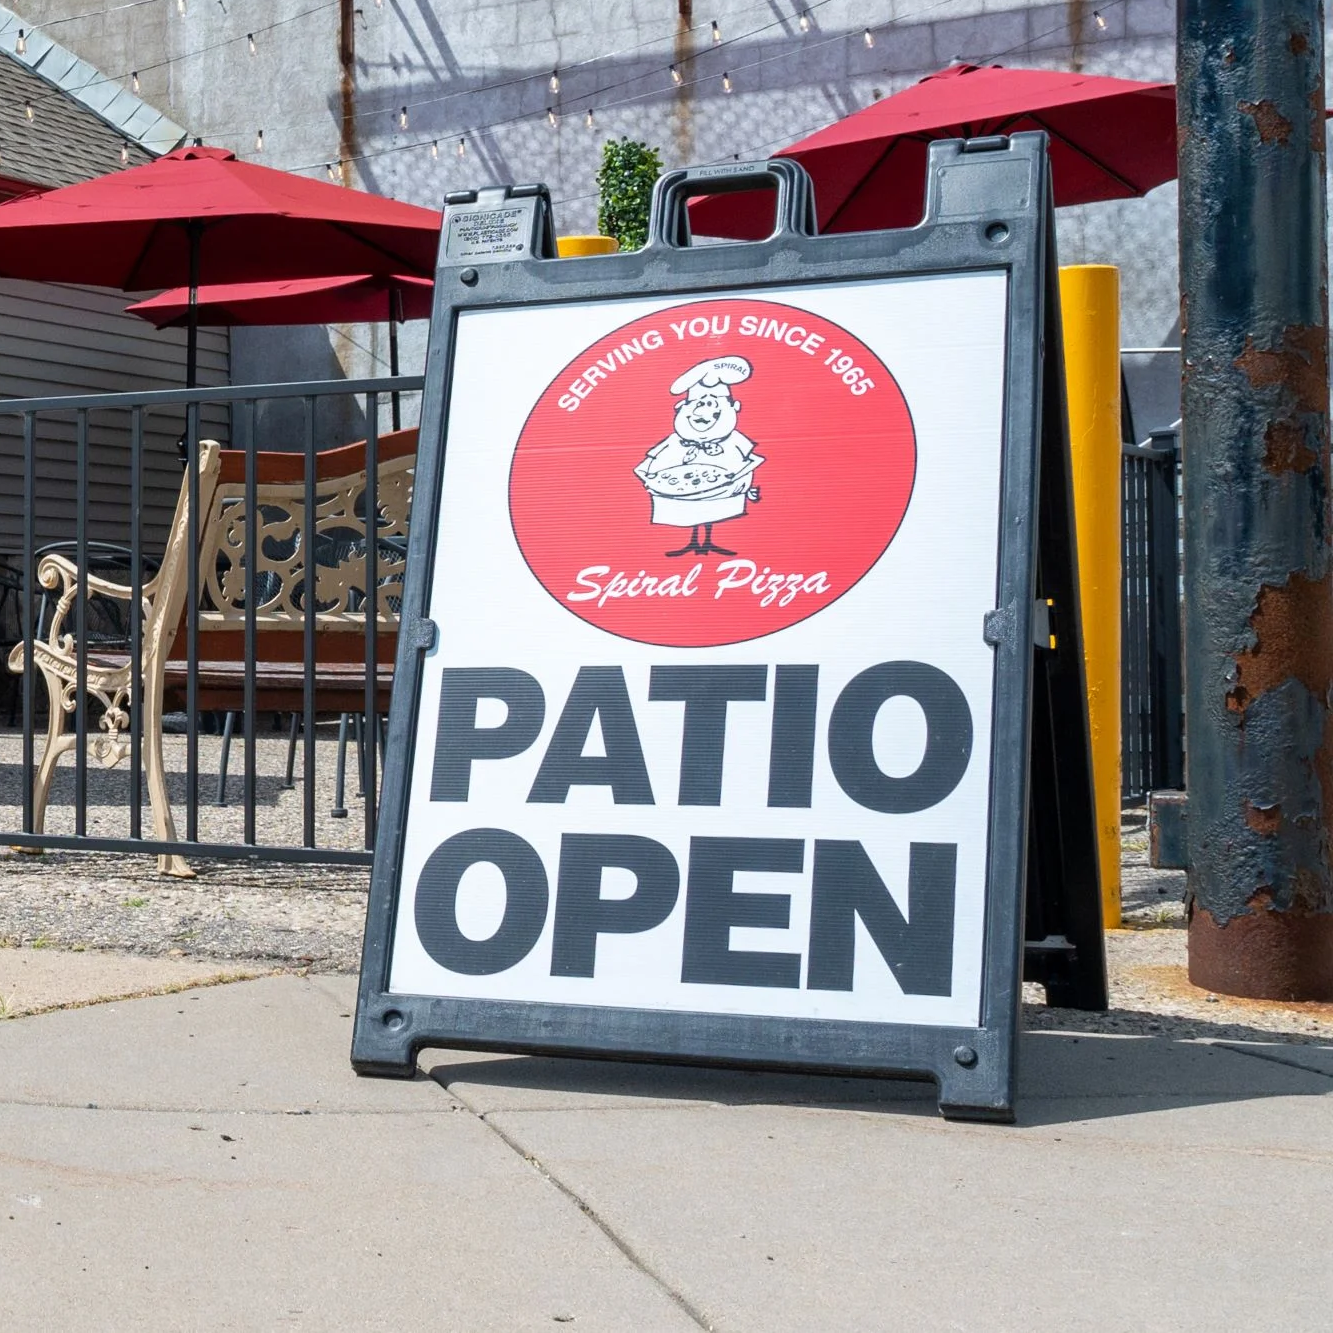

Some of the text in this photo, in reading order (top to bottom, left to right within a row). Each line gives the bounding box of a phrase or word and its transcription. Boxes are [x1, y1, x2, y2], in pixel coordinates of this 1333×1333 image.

[557, 314, 875, 412] SERVING YOU SINCE 1965
[713, 362, 747, 375] SPIRAL
[566, 559, 831, 608] Spiral Pizza
[429, 660, 974, 815] PATIO
[413, 827, 958, 997] OPEN
